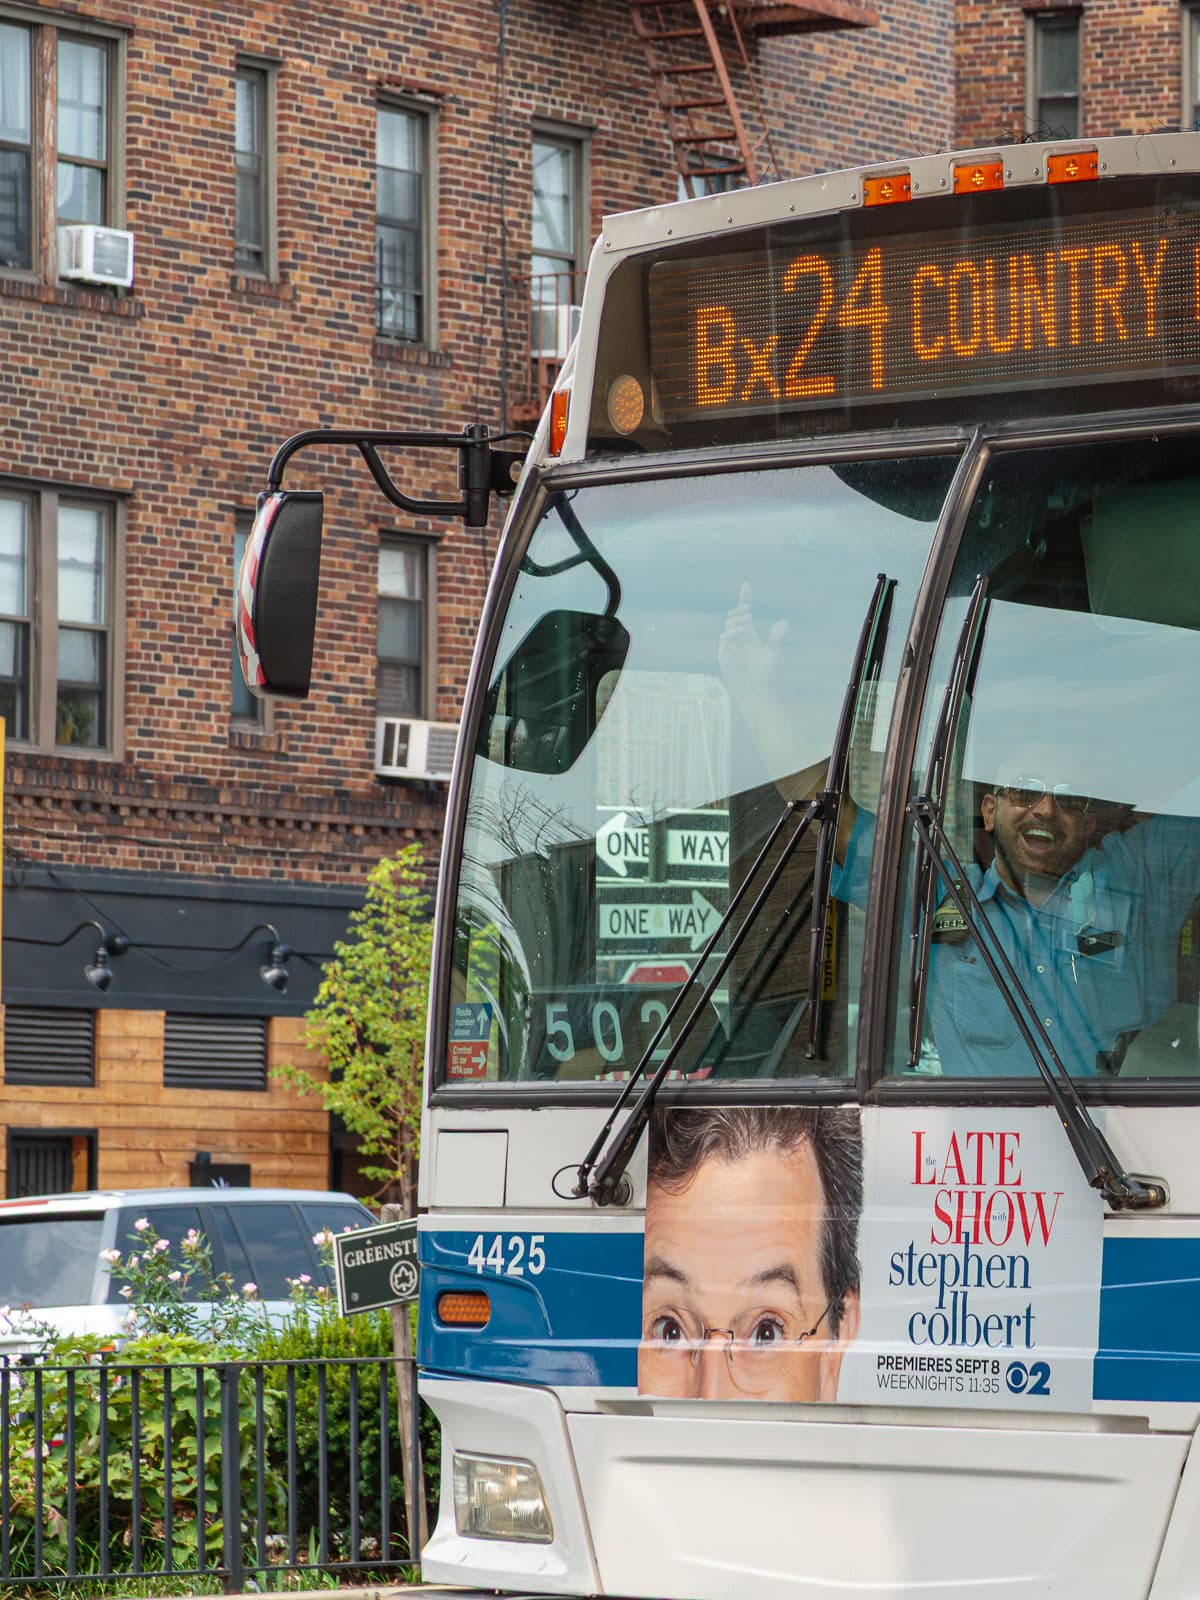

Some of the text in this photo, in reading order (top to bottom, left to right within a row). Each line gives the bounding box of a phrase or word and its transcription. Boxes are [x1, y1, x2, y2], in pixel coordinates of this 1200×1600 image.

[696, 246, 889, 406] Bx24
[912, 238, 1168, 361] COUNTRY
[607, 832, 729, 862] ONE WAY
[609, 908, 711, 934] ONE WAY
[911, 1130, 1023, 1187] LATE
[925, 1156, 937, 1167] the
[931, 1189, 1065, 1247] SHOW
[992, 1211, 1008, 1223] with
[468, 1234, 546, 1276] 4425
[888, 1231, 1032, 1310] stephen
[908, 1290, 1036, 1349] colbert
[877, 1355, 1000, 1375] PREMIERES SEPT 8
[876, 1373, 1000, 1394] WEEKNIGHTS 11:35
